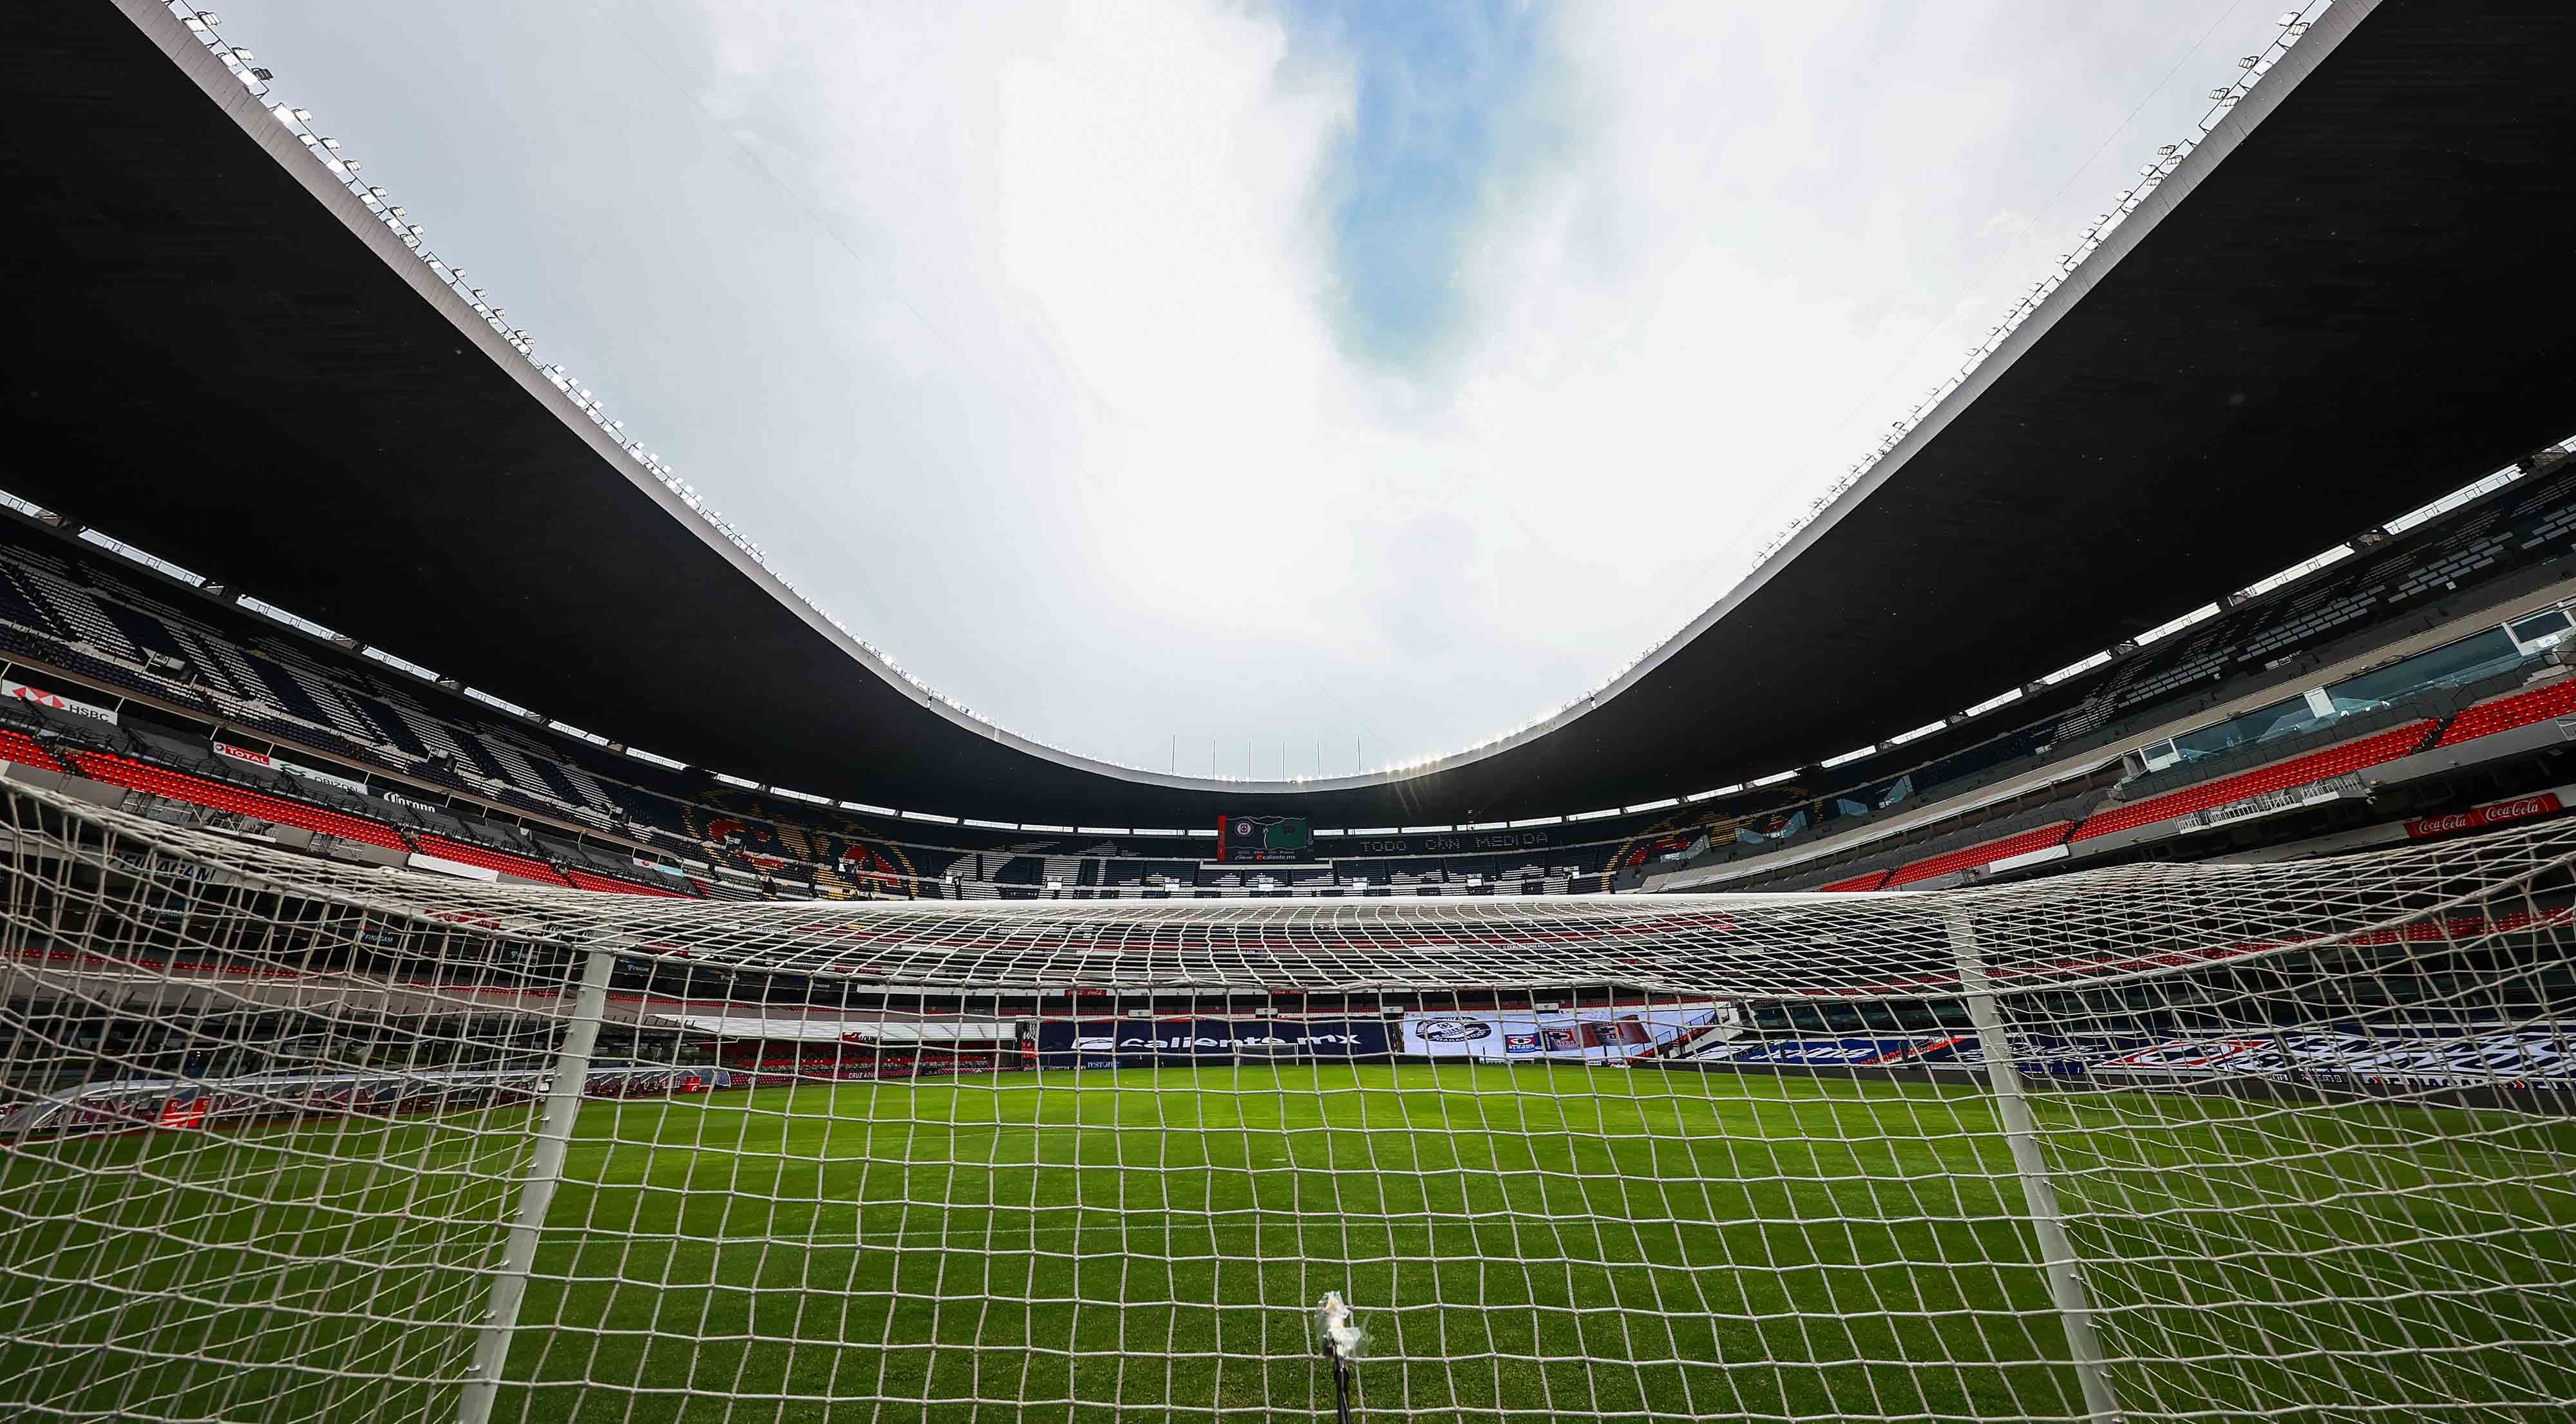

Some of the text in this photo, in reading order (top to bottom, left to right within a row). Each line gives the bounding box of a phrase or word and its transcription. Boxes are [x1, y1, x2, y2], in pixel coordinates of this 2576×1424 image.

[69, 704, 109, 722] HSBC
[227, 748, 269, 764] TOTAL
[2485, 797, 2539, 821] Coca-Cola
[2419, 813, 2466, 833] Coca-Cola
[1359, 840, 1407, 851] TODO
[1475, 832, 1548, 848] MEDIDA
[1119, 1033, 1361, 1049] calientemx
